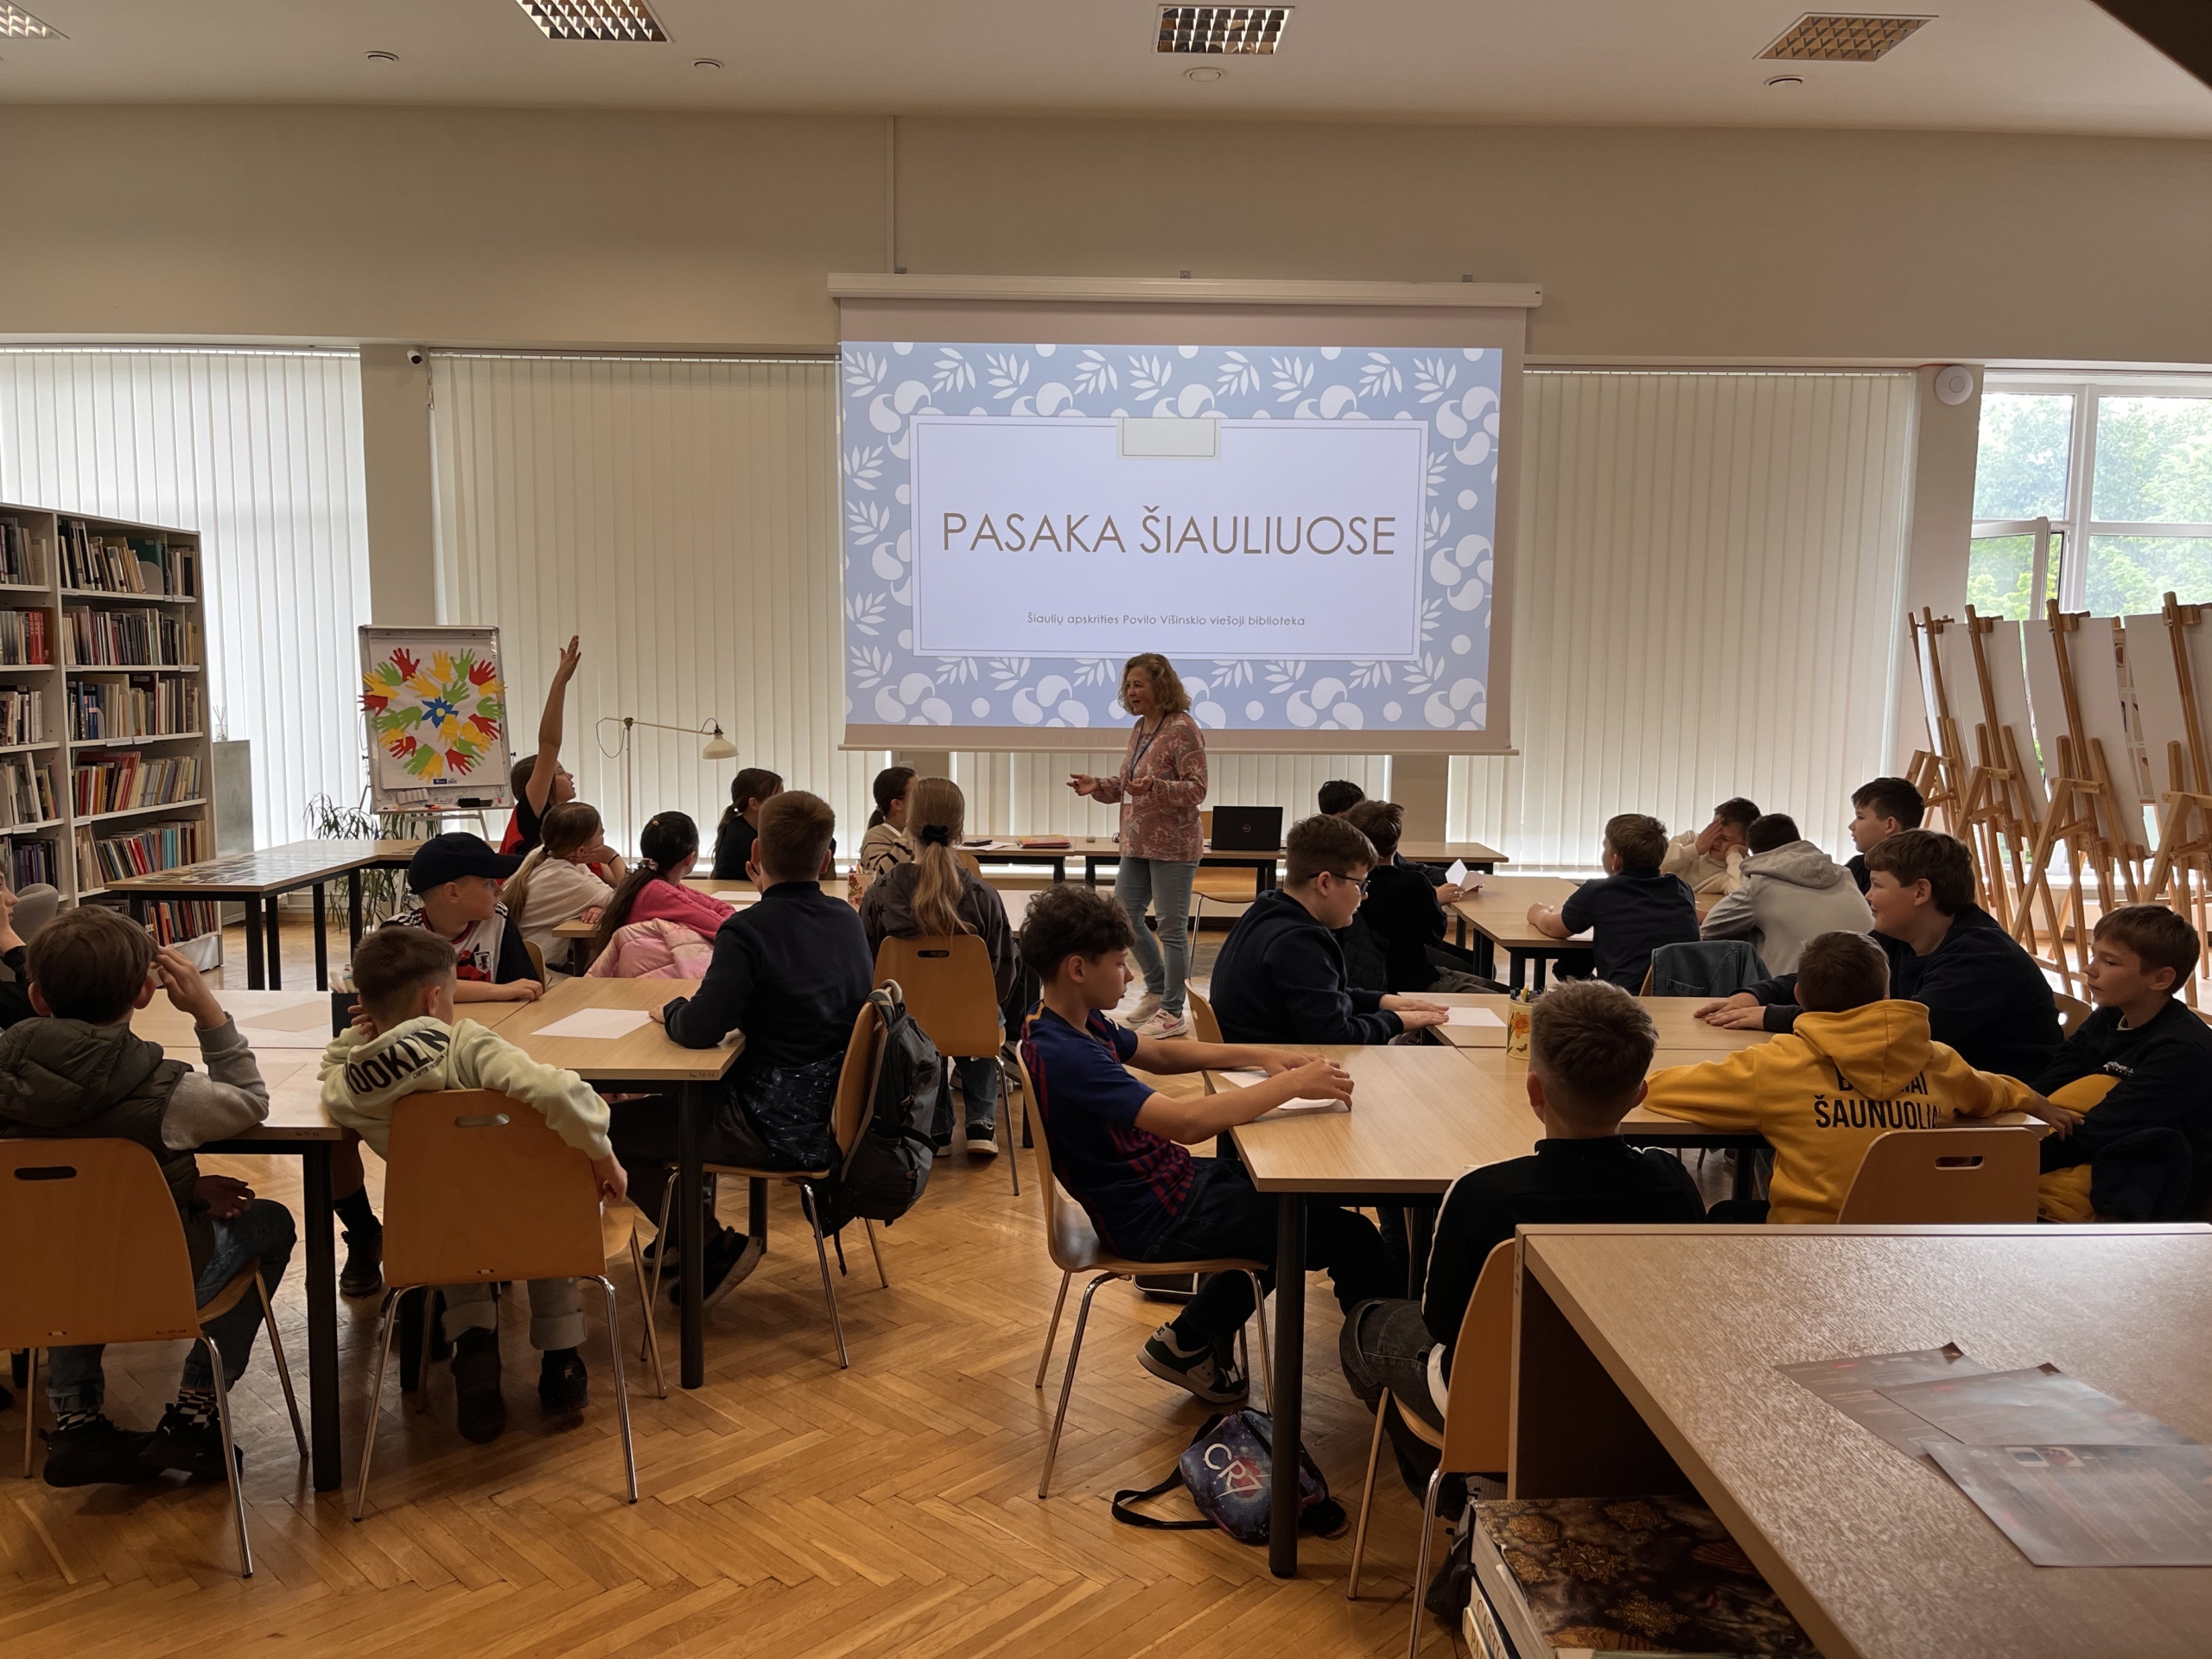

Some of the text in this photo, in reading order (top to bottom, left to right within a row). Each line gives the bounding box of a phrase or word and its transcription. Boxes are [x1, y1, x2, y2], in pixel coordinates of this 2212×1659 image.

[944, 505, 1396, 556] PASAKA ŠIAULIUOSE
[1027, 612, 1306, 627] Šiaulių apskrities Povilo Višinskio viešoji biblioteka
[343, 1028, 450, 1095] OOKLN
[1813, 1094, 1942, 1130] ŠAUNUOLIA
